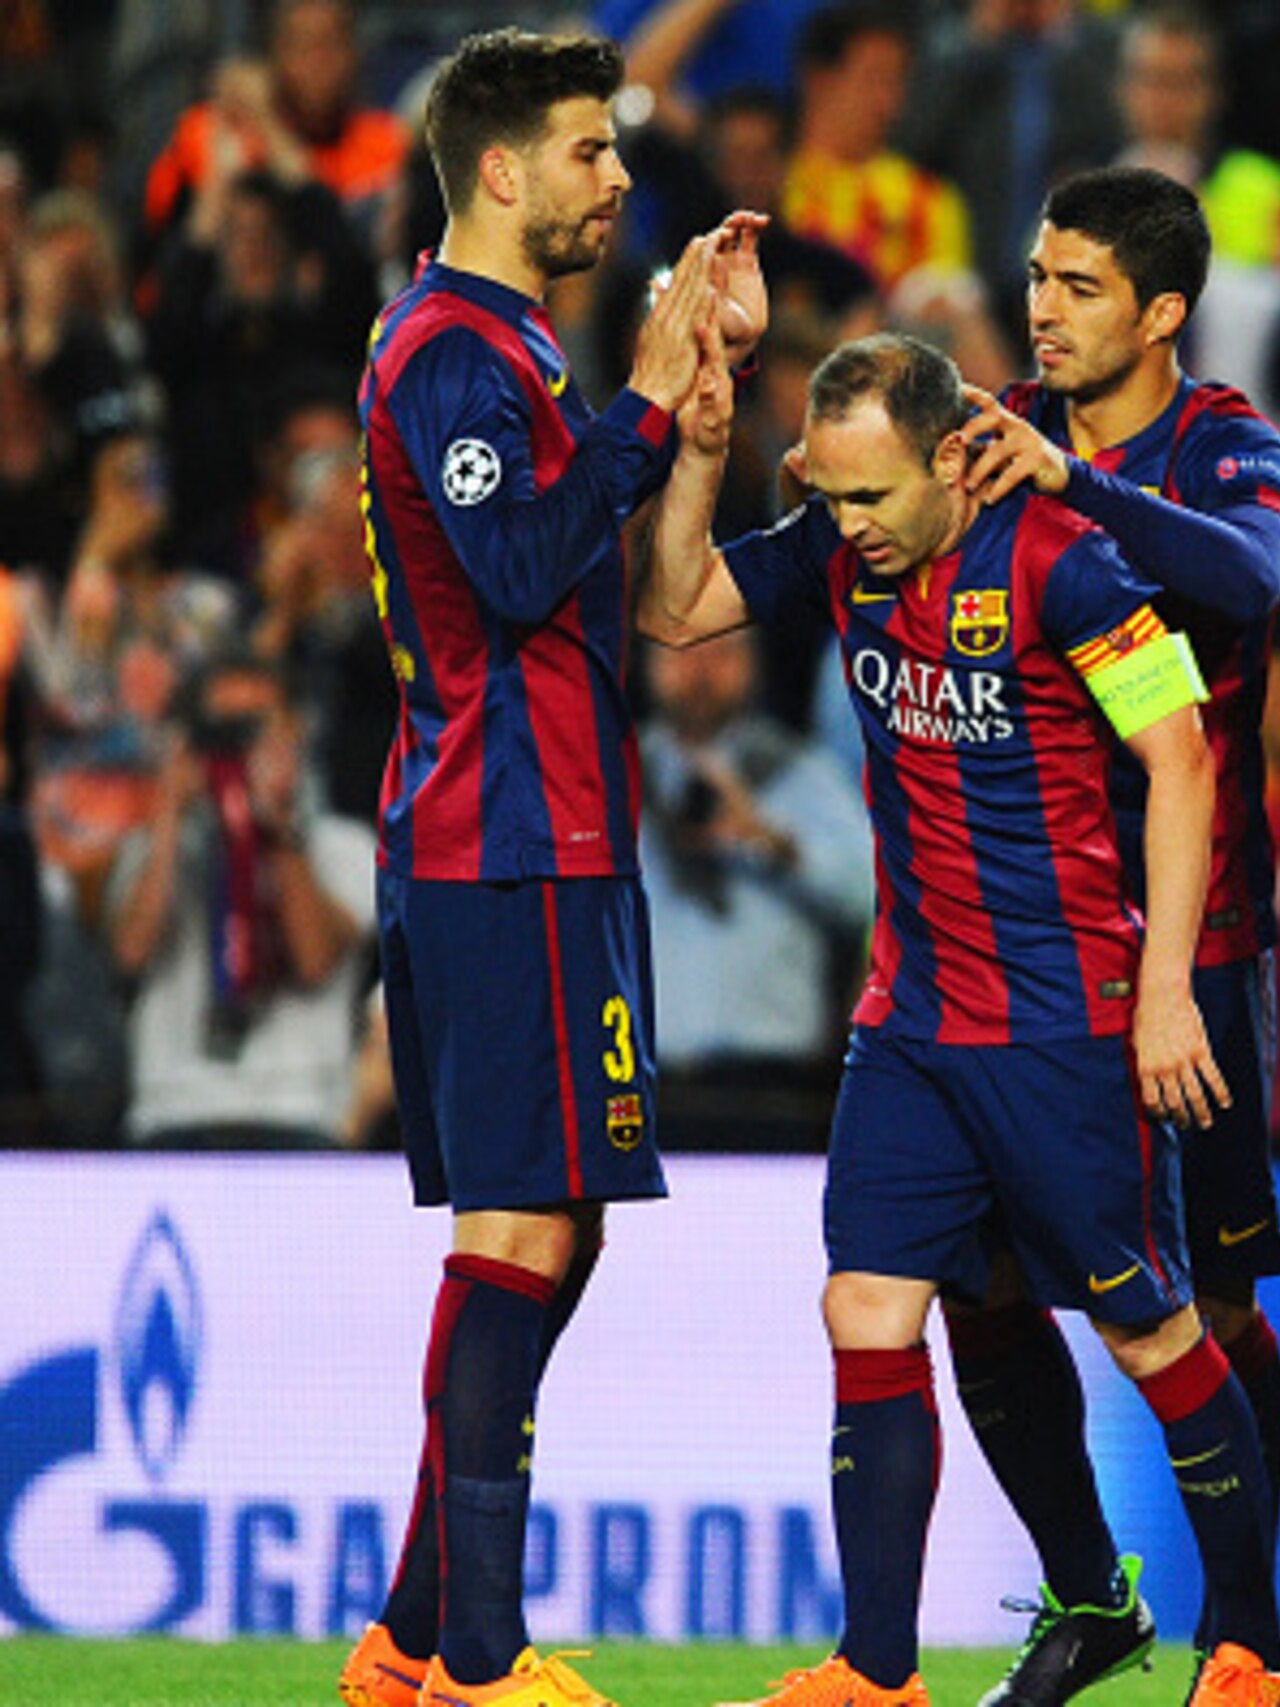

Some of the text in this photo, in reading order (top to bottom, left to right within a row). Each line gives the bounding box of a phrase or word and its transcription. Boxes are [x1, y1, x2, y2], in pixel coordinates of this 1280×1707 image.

[853, 649, 1009, 716] QATAR
[887, 704, 1014, 743] AIRWAYS
[602, 995, 635, 1083] 3
